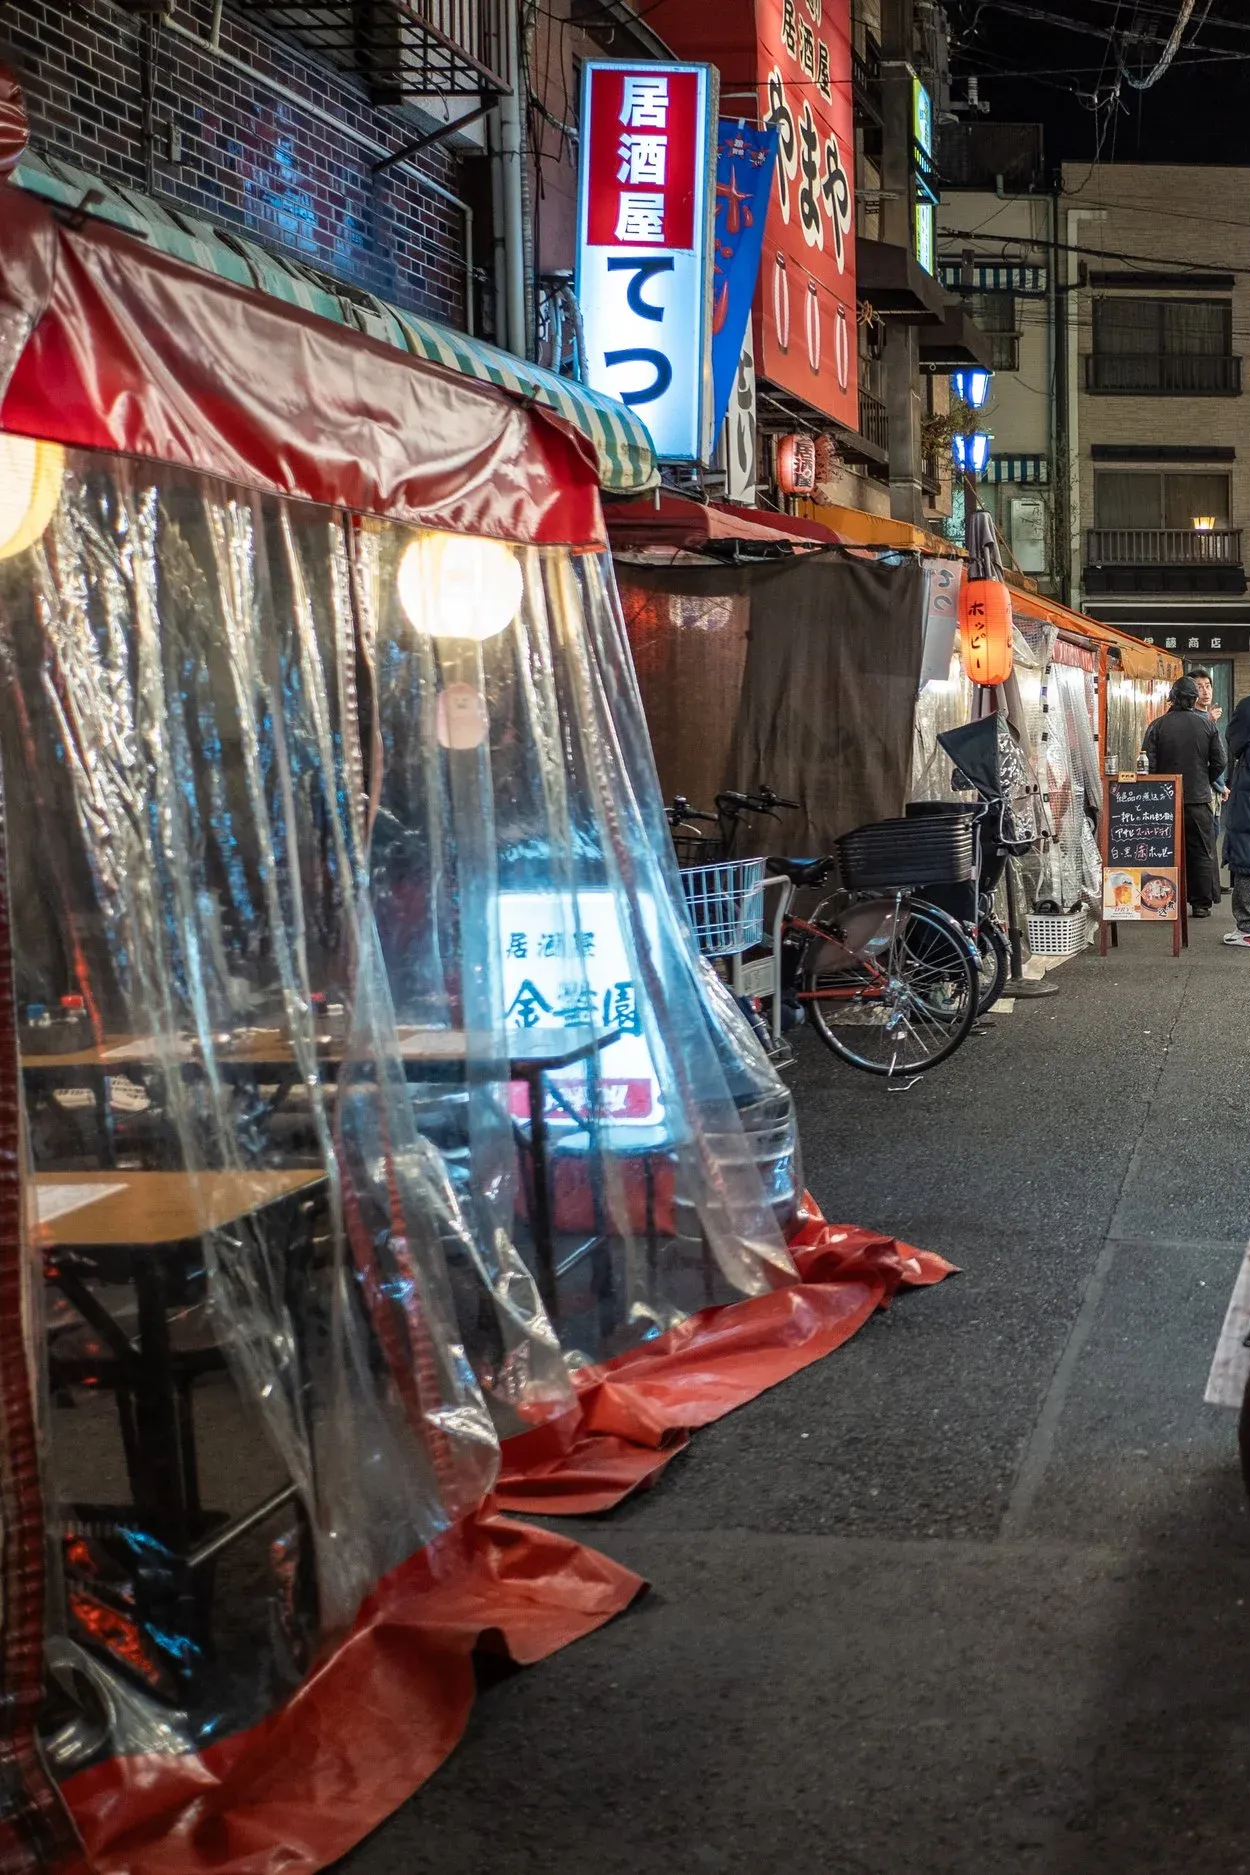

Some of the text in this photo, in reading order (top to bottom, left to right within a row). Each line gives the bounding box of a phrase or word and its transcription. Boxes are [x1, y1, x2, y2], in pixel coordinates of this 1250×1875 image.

[614, 76, 669, 243] 居酒屋
[764, 66, 851, 274] やまや
[603, 256, 674, 405] てつ
[968, 602, 987, 669] ホッピー
